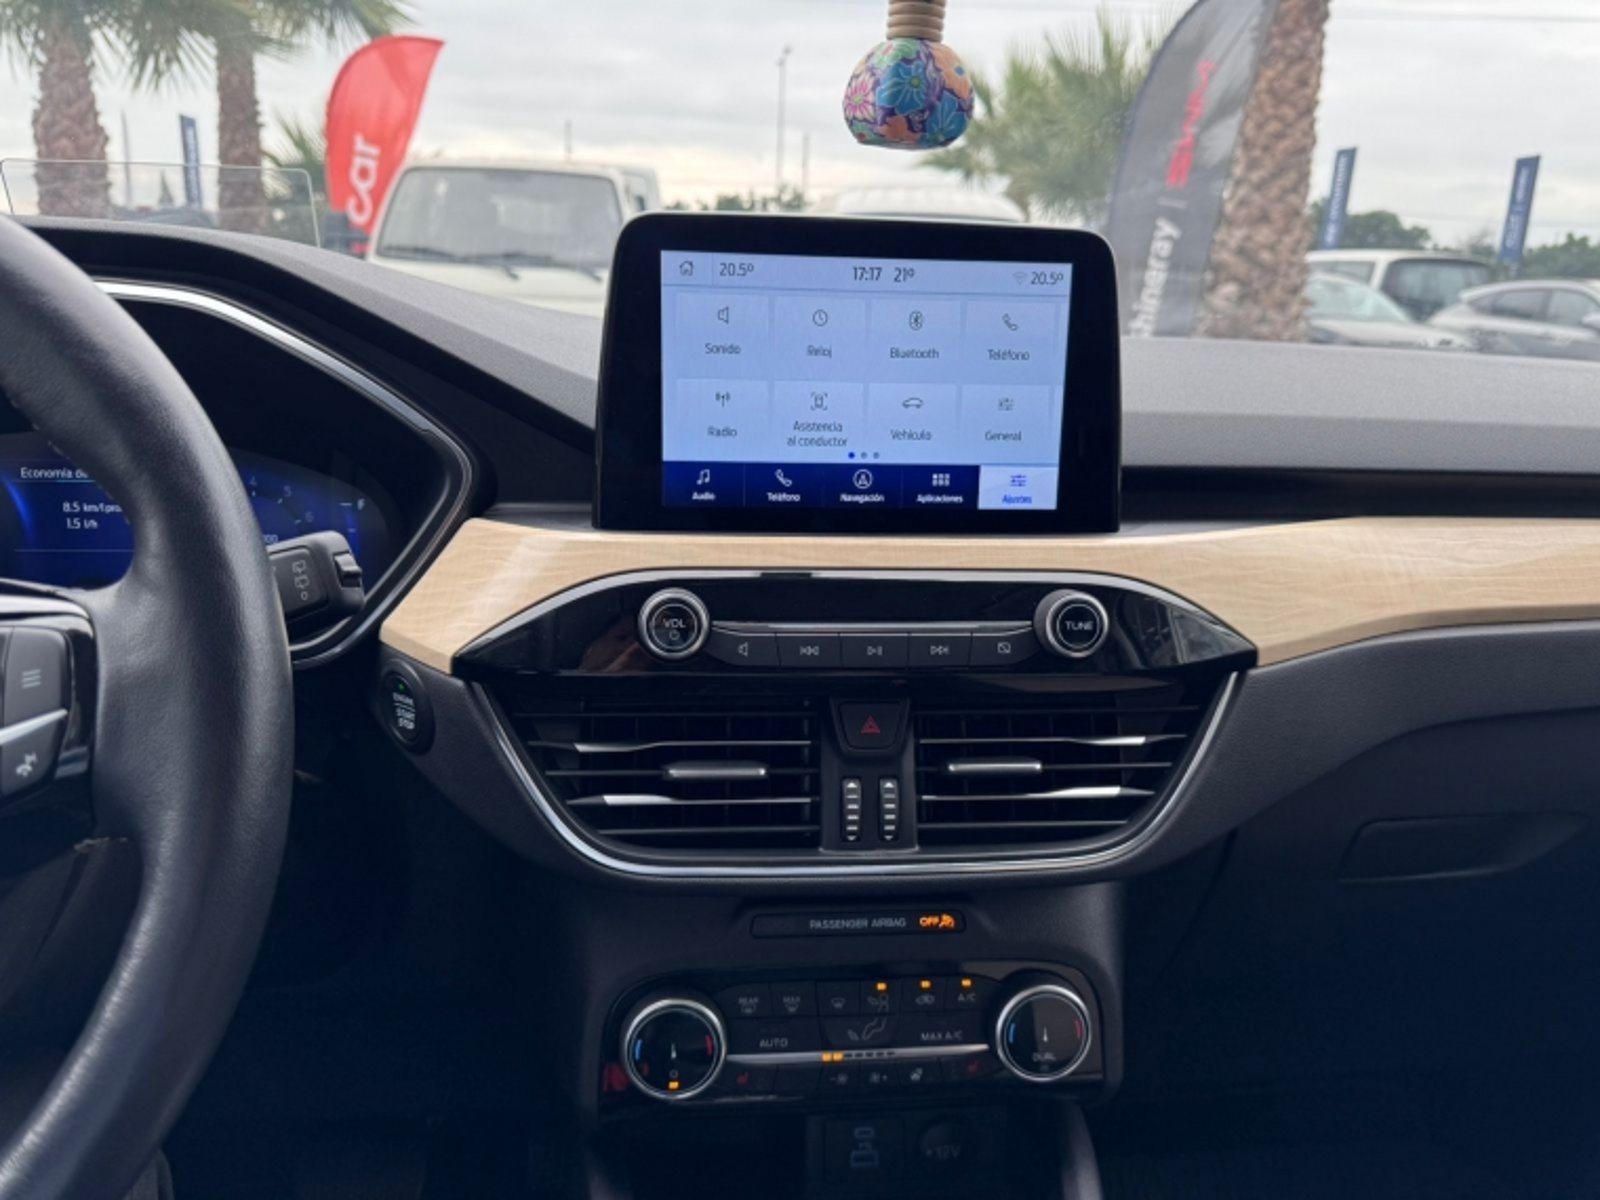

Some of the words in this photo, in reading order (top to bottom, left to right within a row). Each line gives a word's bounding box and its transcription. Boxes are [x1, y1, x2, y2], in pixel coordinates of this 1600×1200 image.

[852, 265, 882, 282] 17:17
[1128, 217, 1181, 337] hineray
[704, 342, 741, 355] Sonido
[806, 345, 832, 358] Reloj
[889, 347, 940, 360] Bluetooth
[987, 348, 1030, 361] Teléfono
[707, 425, 737, 437] Radio
[793, 420, 843, 432] Asistencia
[786, 436, 797, 447] al
[798, 436, 848, 448] conductor
[984, 430, 1022, 442] General
[691, 491, 716, 502] Audio
[766, 491, 800, 502] Teléfono
[840, 492, 885, 504] Navegación
[916, 493, 963, 505] Aplicaciones
[1002, 494, 1032, 505] Ajustes
[62, 500, 81, 513] 8.5
[65, 517, 81, 530] 1.5
[662, 618, 687, 629] VOL
[1064, 620, 1094, 631] TUNE
[809, 918, 868, 930] PASSENGER
[871, 917, 906, 928] AIRBAG
[918, 915, 940, 927] OFF
[957, 992, 976, 1003] A/C
[921, 1031, 944, 1042] MAX
[945, 1030, 964, 1041] A/C
[759, 1037, 789, 1049] AUTO
